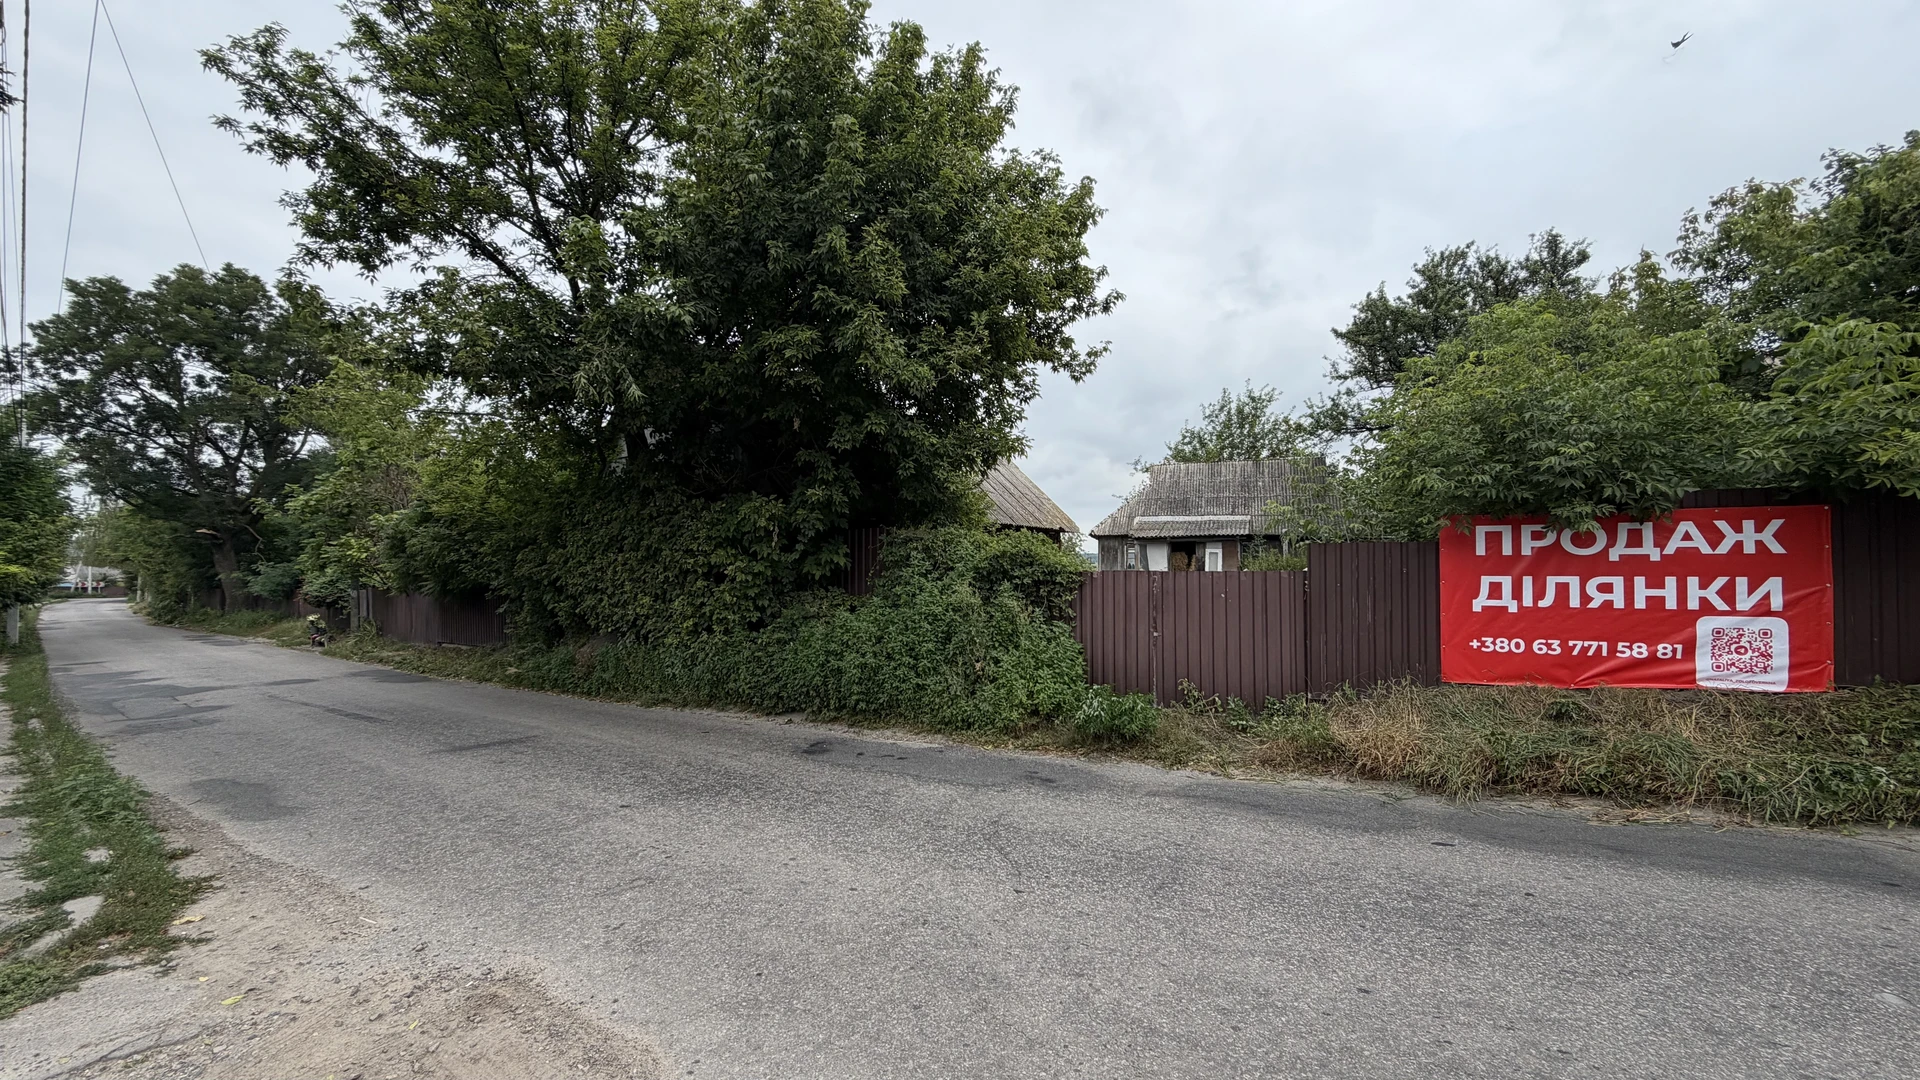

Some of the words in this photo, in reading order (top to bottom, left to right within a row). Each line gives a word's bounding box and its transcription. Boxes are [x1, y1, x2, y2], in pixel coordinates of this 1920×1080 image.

[1475, 518, 1787, 562] ПРОДАЖ
[1472, 575, 1784, 613] ДІЛЯНКИ
[1469, 637, 1526, 654] +380
[1532, 638, 1562, 655] 63
[1568, 640, 1608, 657] 771
[1615, 641, 1649, 659] 58
[1656, 643, 1683, 660] 81
